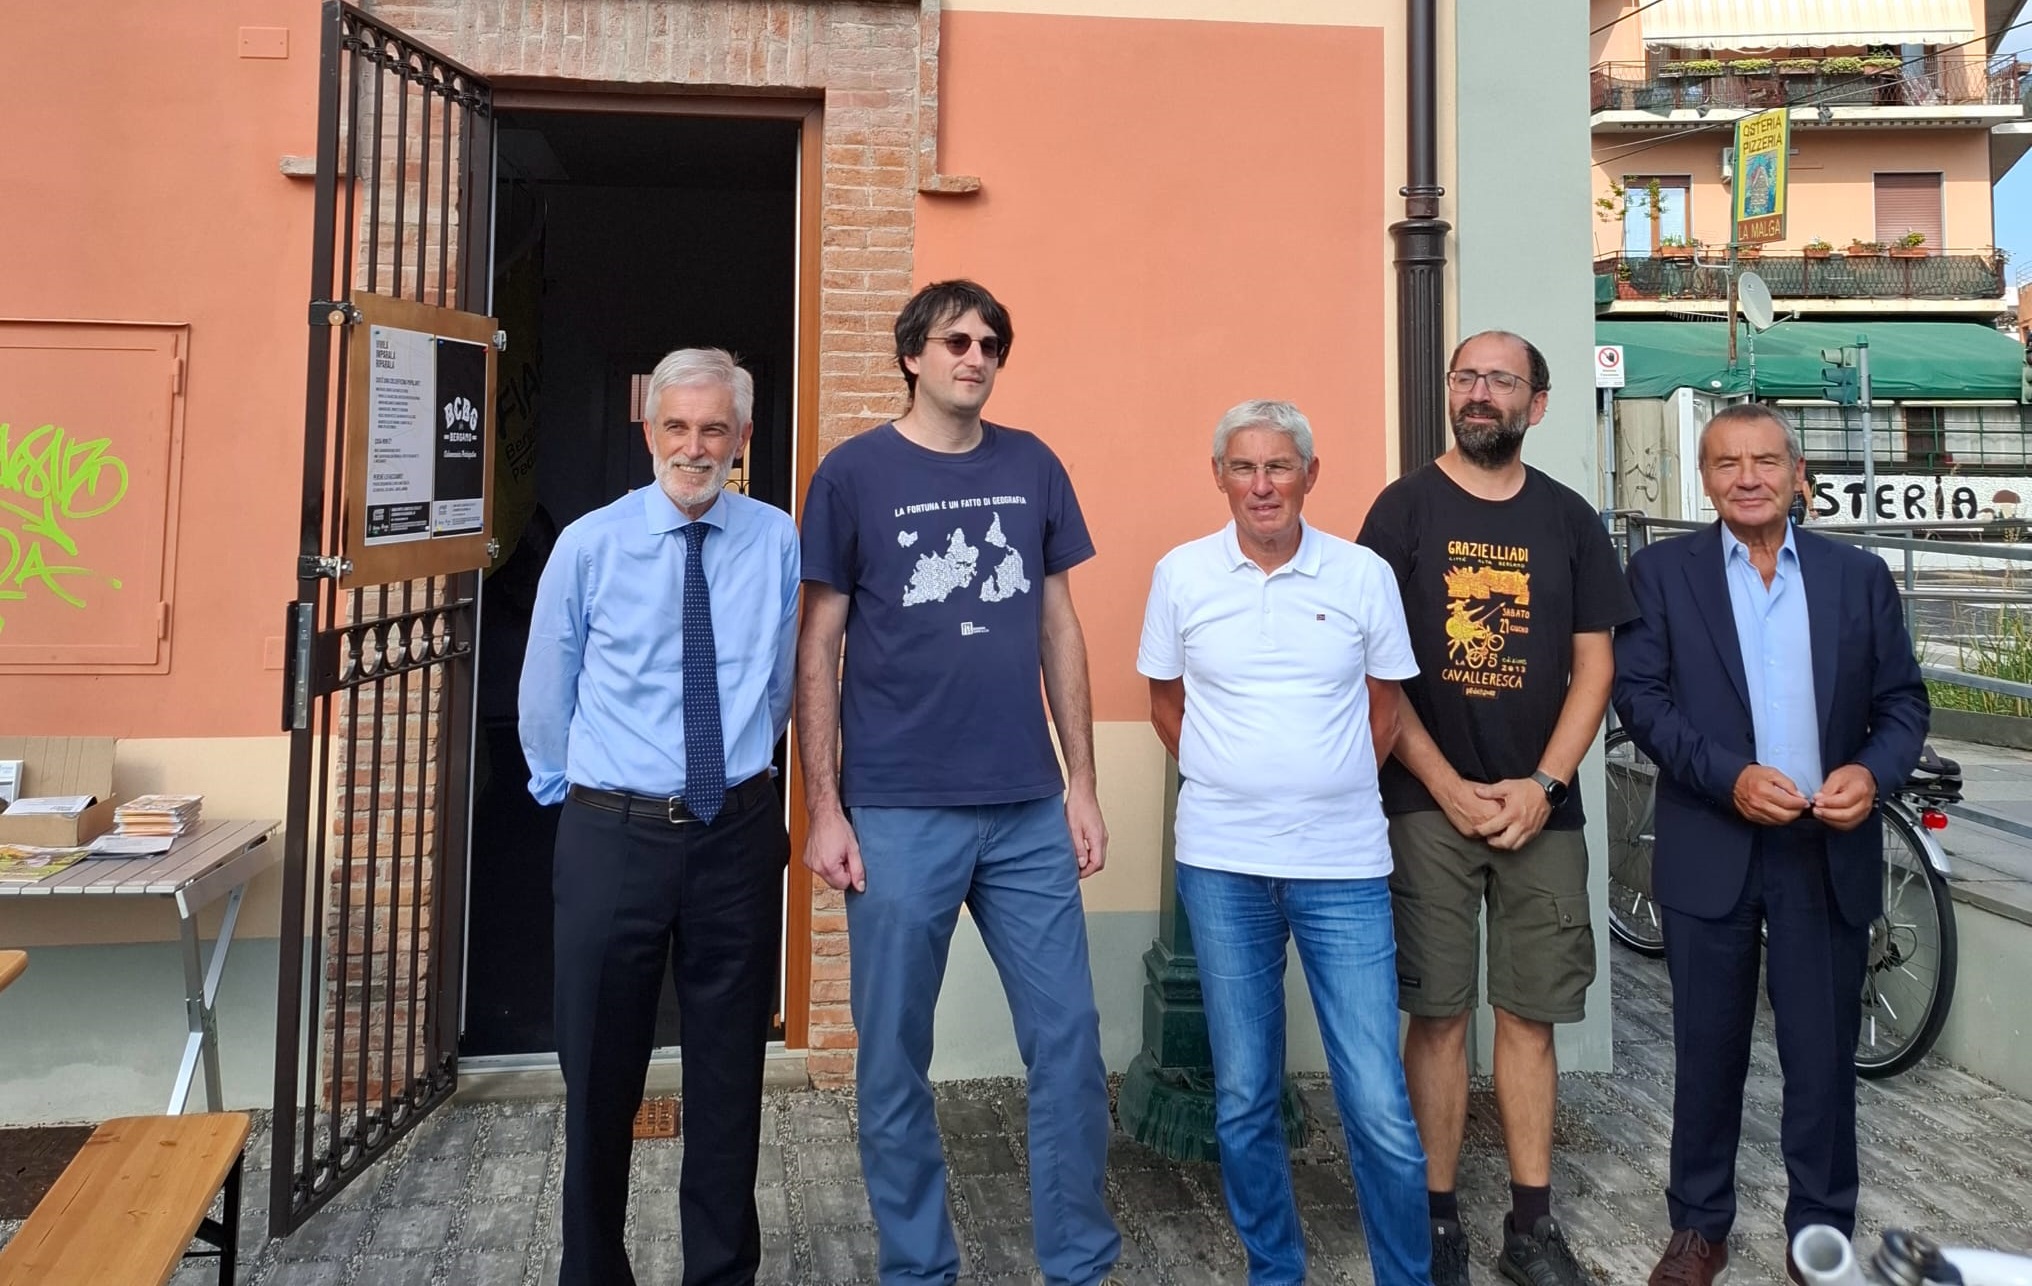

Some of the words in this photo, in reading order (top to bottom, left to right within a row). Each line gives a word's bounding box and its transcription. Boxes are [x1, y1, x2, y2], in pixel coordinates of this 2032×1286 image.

[1743, 115, 1782, 137] OSTERIA
[1743, 134, 1783, 155] PIZZERIA
[1738, 225, 1749, 241] LA
[1751, 220, 1780, 239] MALGA
[894, 507, 906, 518] LA
[907, 501, 940, 515] FORTUNA
[948, 500, 959, 509] UN
[961, 498, 981, 509] FATTO
[983, 498, 991, 506] DI
[992, 496, 1027, 505] GEOGRAFIA
[1812, 475, 1978, 520] STERIA
[1448, 541, 1529, 563] GRAZIELLIADI
[1502, 608, 1530, 619] SABATO
[1442, 668, 1523, 688] CAVALLERESCA
